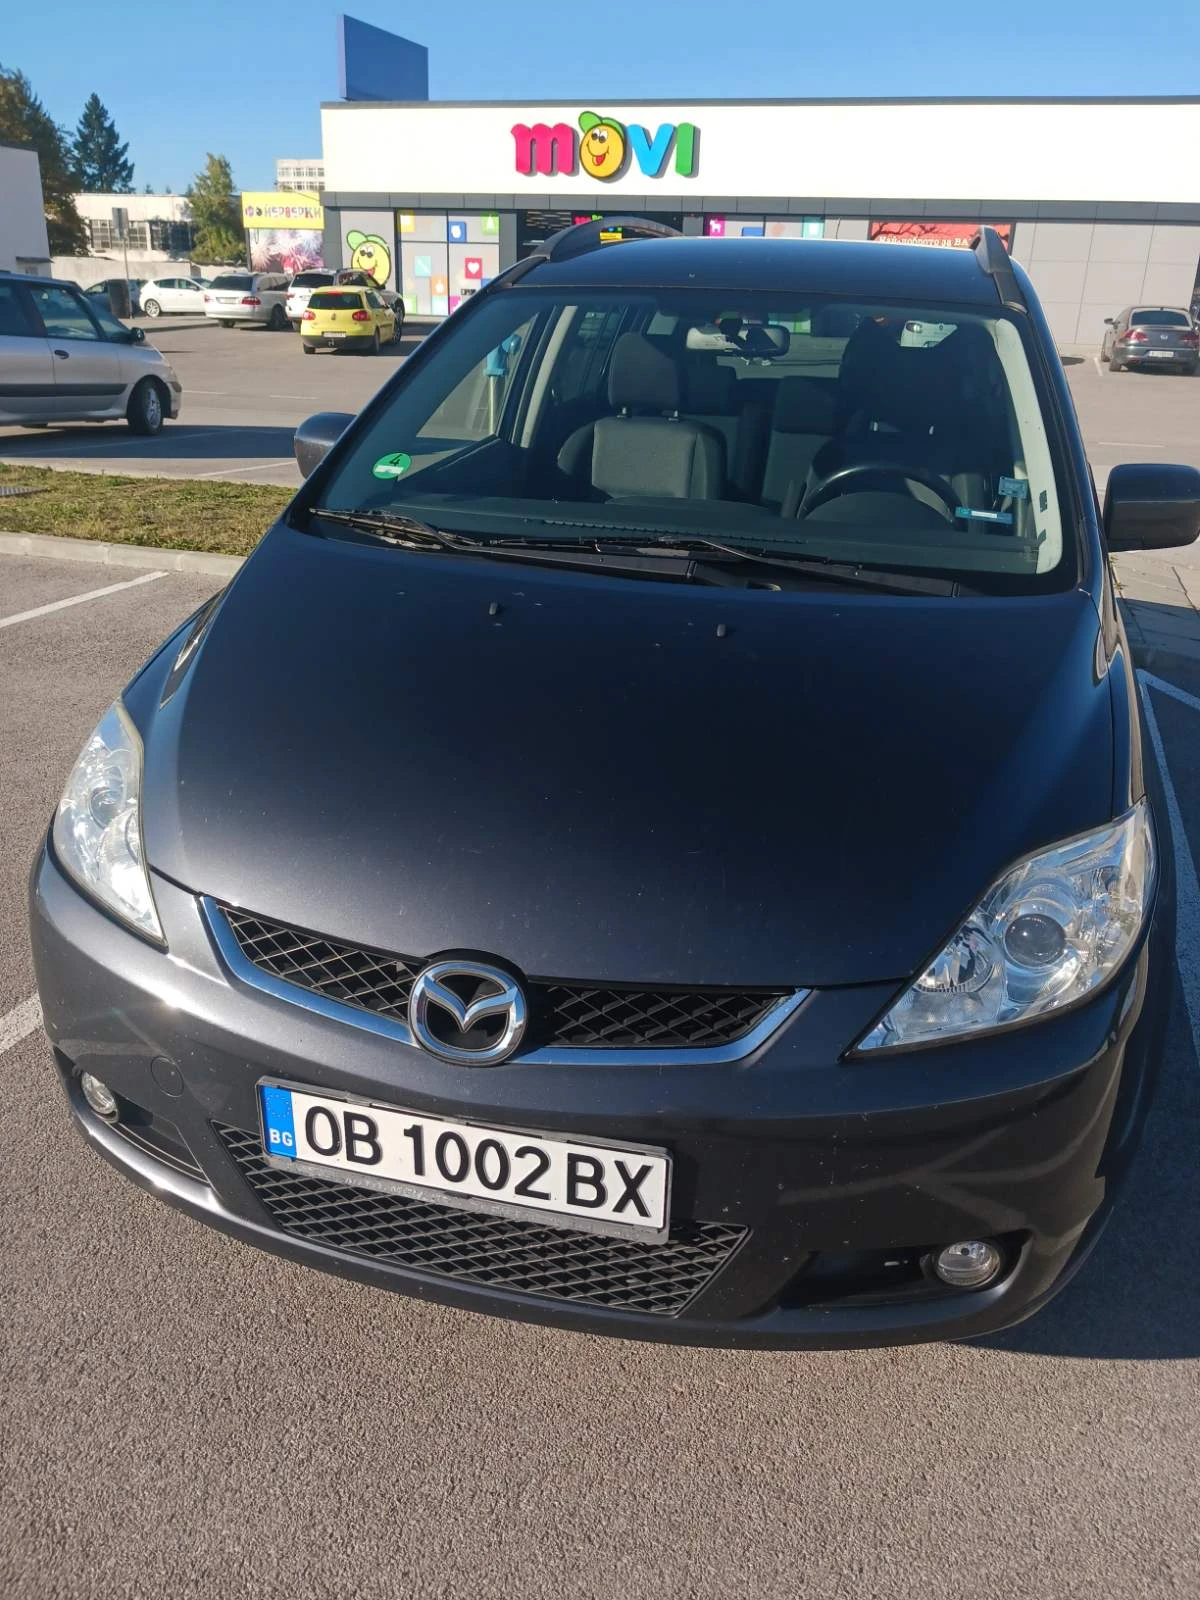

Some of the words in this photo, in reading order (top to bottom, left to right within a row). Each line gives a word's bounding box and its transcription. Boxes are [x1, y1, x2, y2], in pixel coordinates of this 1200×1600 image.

[389, 453, 402, 466] 4
[269, 1128, 294, 1147] BG
[305, 1105, 383, 1166] OB
[403, 1123, 552, 1201] 1002
[566, 1152, 653, 1218] BX
